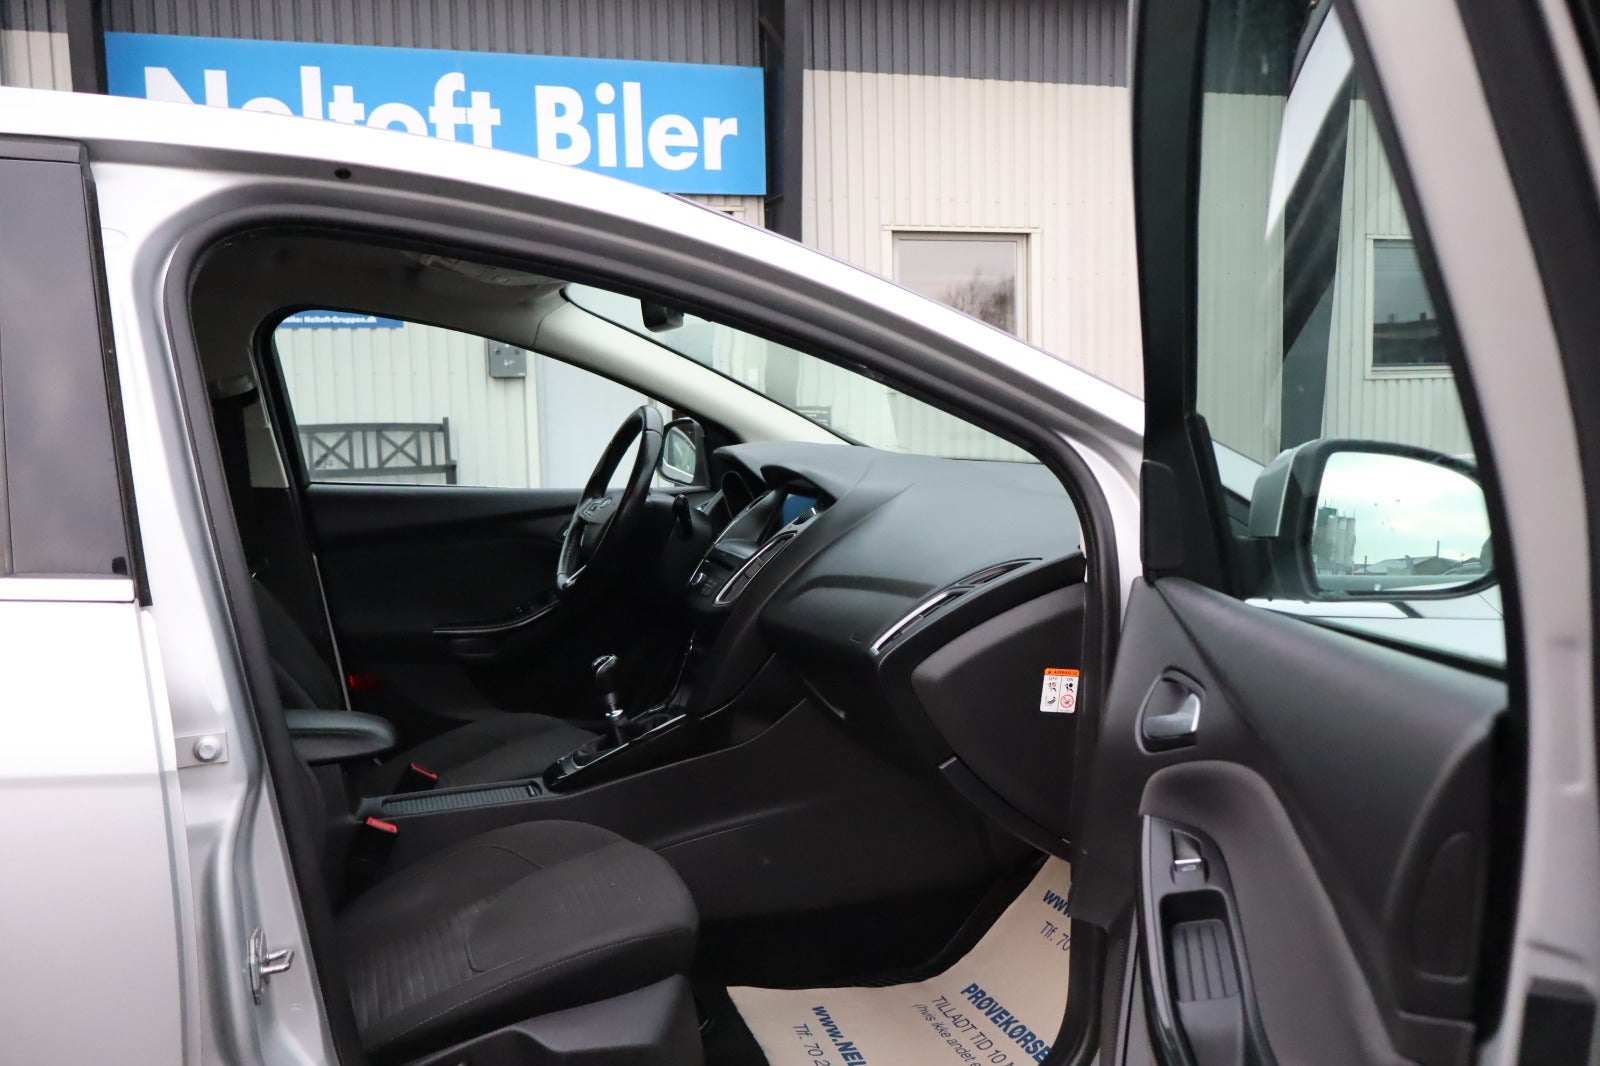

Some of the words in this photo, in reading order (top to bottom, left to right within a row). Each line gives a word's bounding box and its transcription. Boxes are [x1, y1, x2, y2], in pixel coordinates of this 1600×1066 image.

[144, 65, 501, 149] ltoft
[535, 81, 738, 171] Biler
[803, 1042, 824, 1057] 70
[931, 1021, 951, 1038] ikke
[946, 1038, 977, 1062] andet
[932, 995, 978, 1033] TILLADT
[969, 1031, 994, 1051] TID
[987, 1049, 1007, 1064] 10
